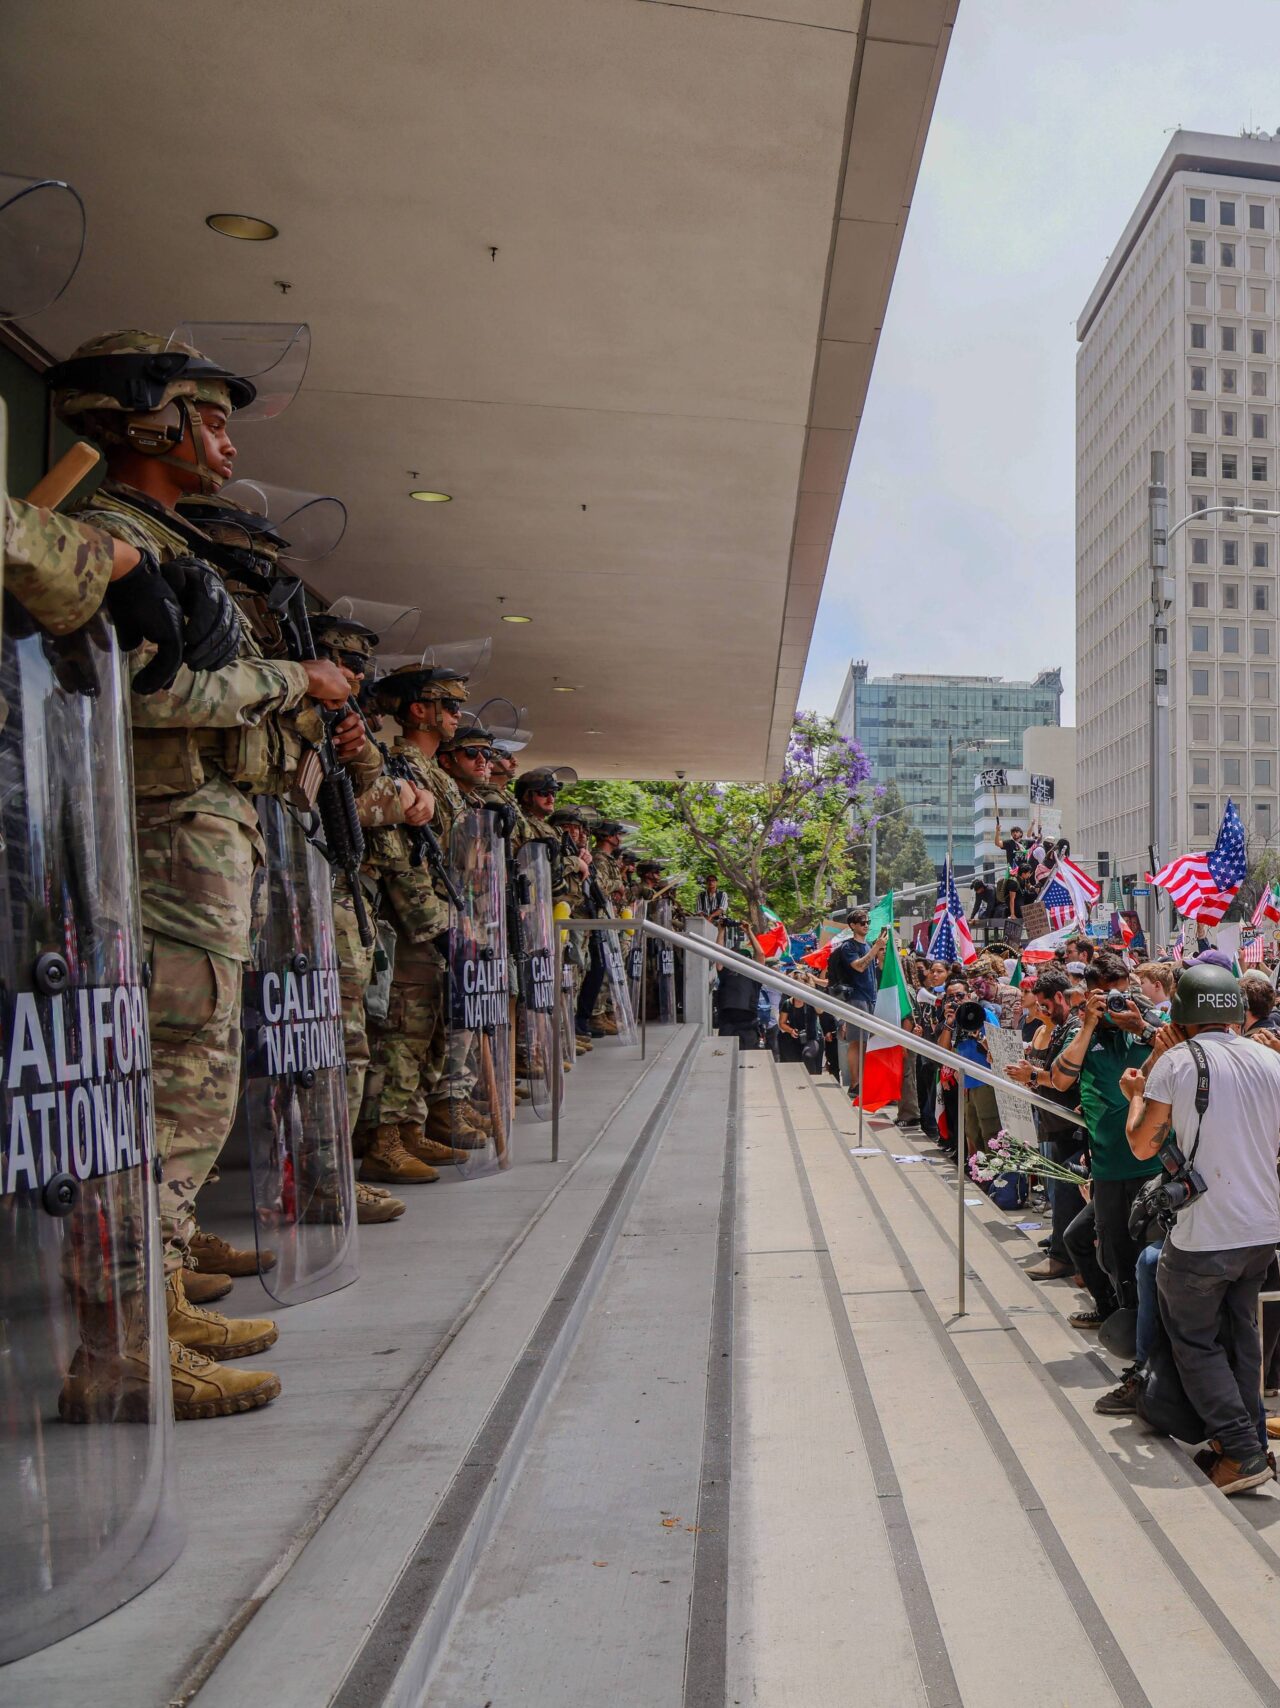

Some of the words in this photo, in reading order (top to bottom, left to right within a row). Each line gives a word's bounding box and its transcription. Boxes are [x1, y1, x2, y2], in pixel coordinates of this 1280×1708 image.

[1197, 993, 1238, 1008] PRESS
[1193, 1046, 1206, 1069] SONY
[0, 1078, 142, 1196] ATIONAL
